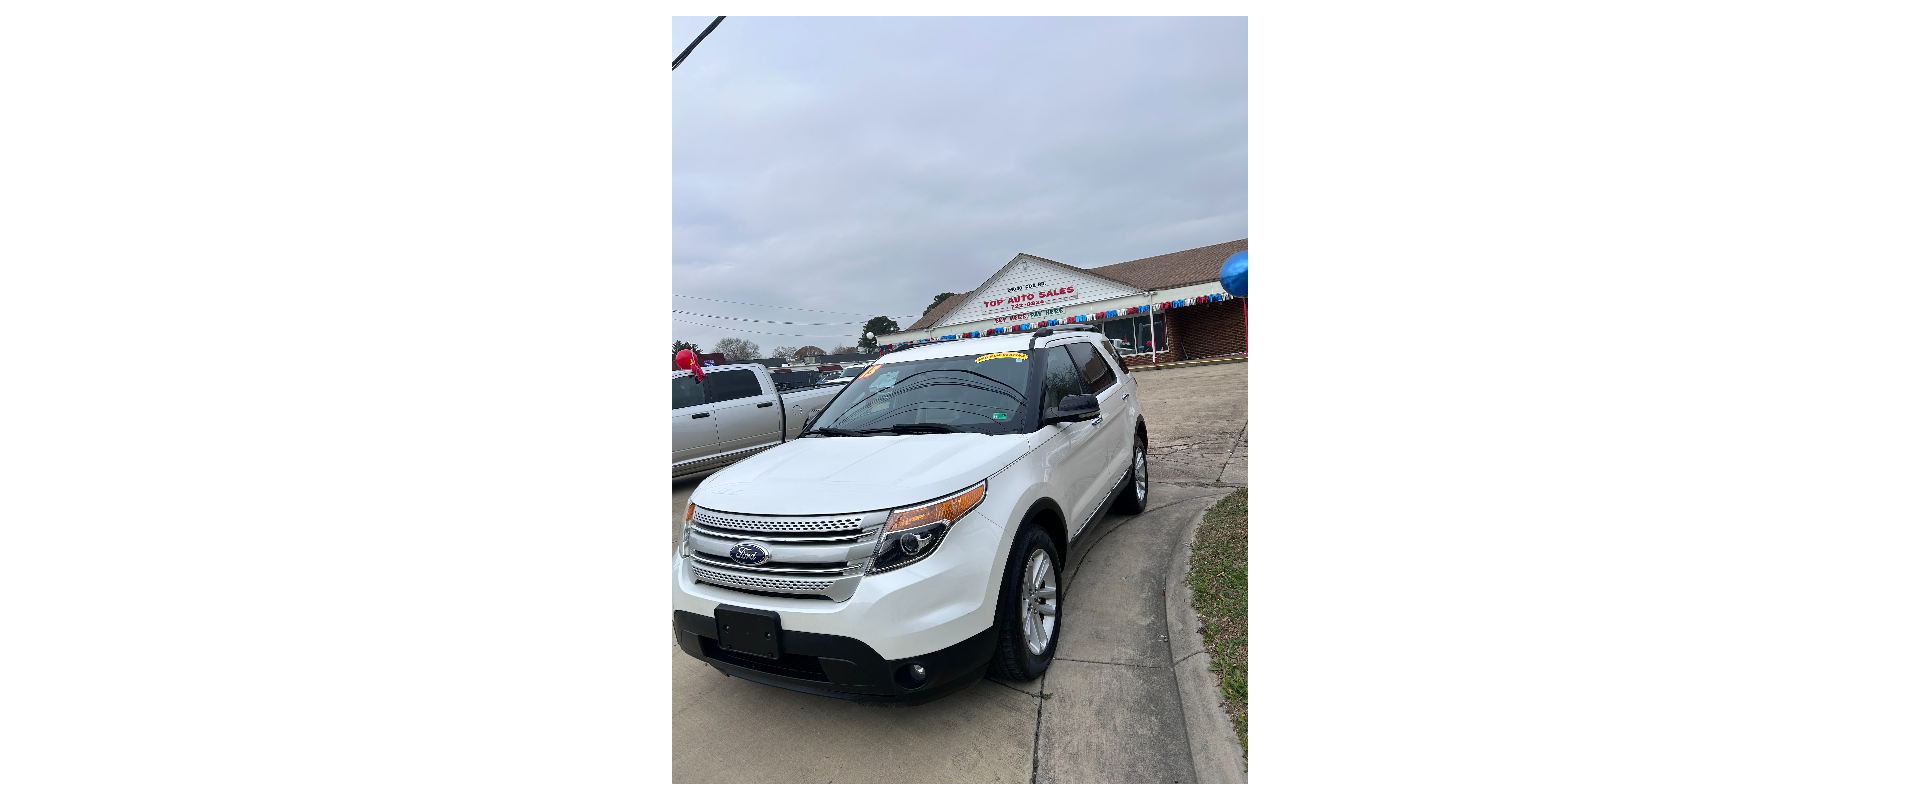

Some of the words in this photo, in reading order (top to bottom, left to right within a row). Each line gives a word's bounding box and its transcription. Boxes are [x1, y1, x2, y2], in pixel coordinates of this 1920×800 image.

[984, 299, 1004, 308] TOP
[1007, 293, 1035, 304] AUTO
[1039, 286, 1075, 298] SALES
[1029, 310, 1042, 318] PAY
[1045, 307, 1064, 315] HERE
[736, 546, 758, 561] Ford
